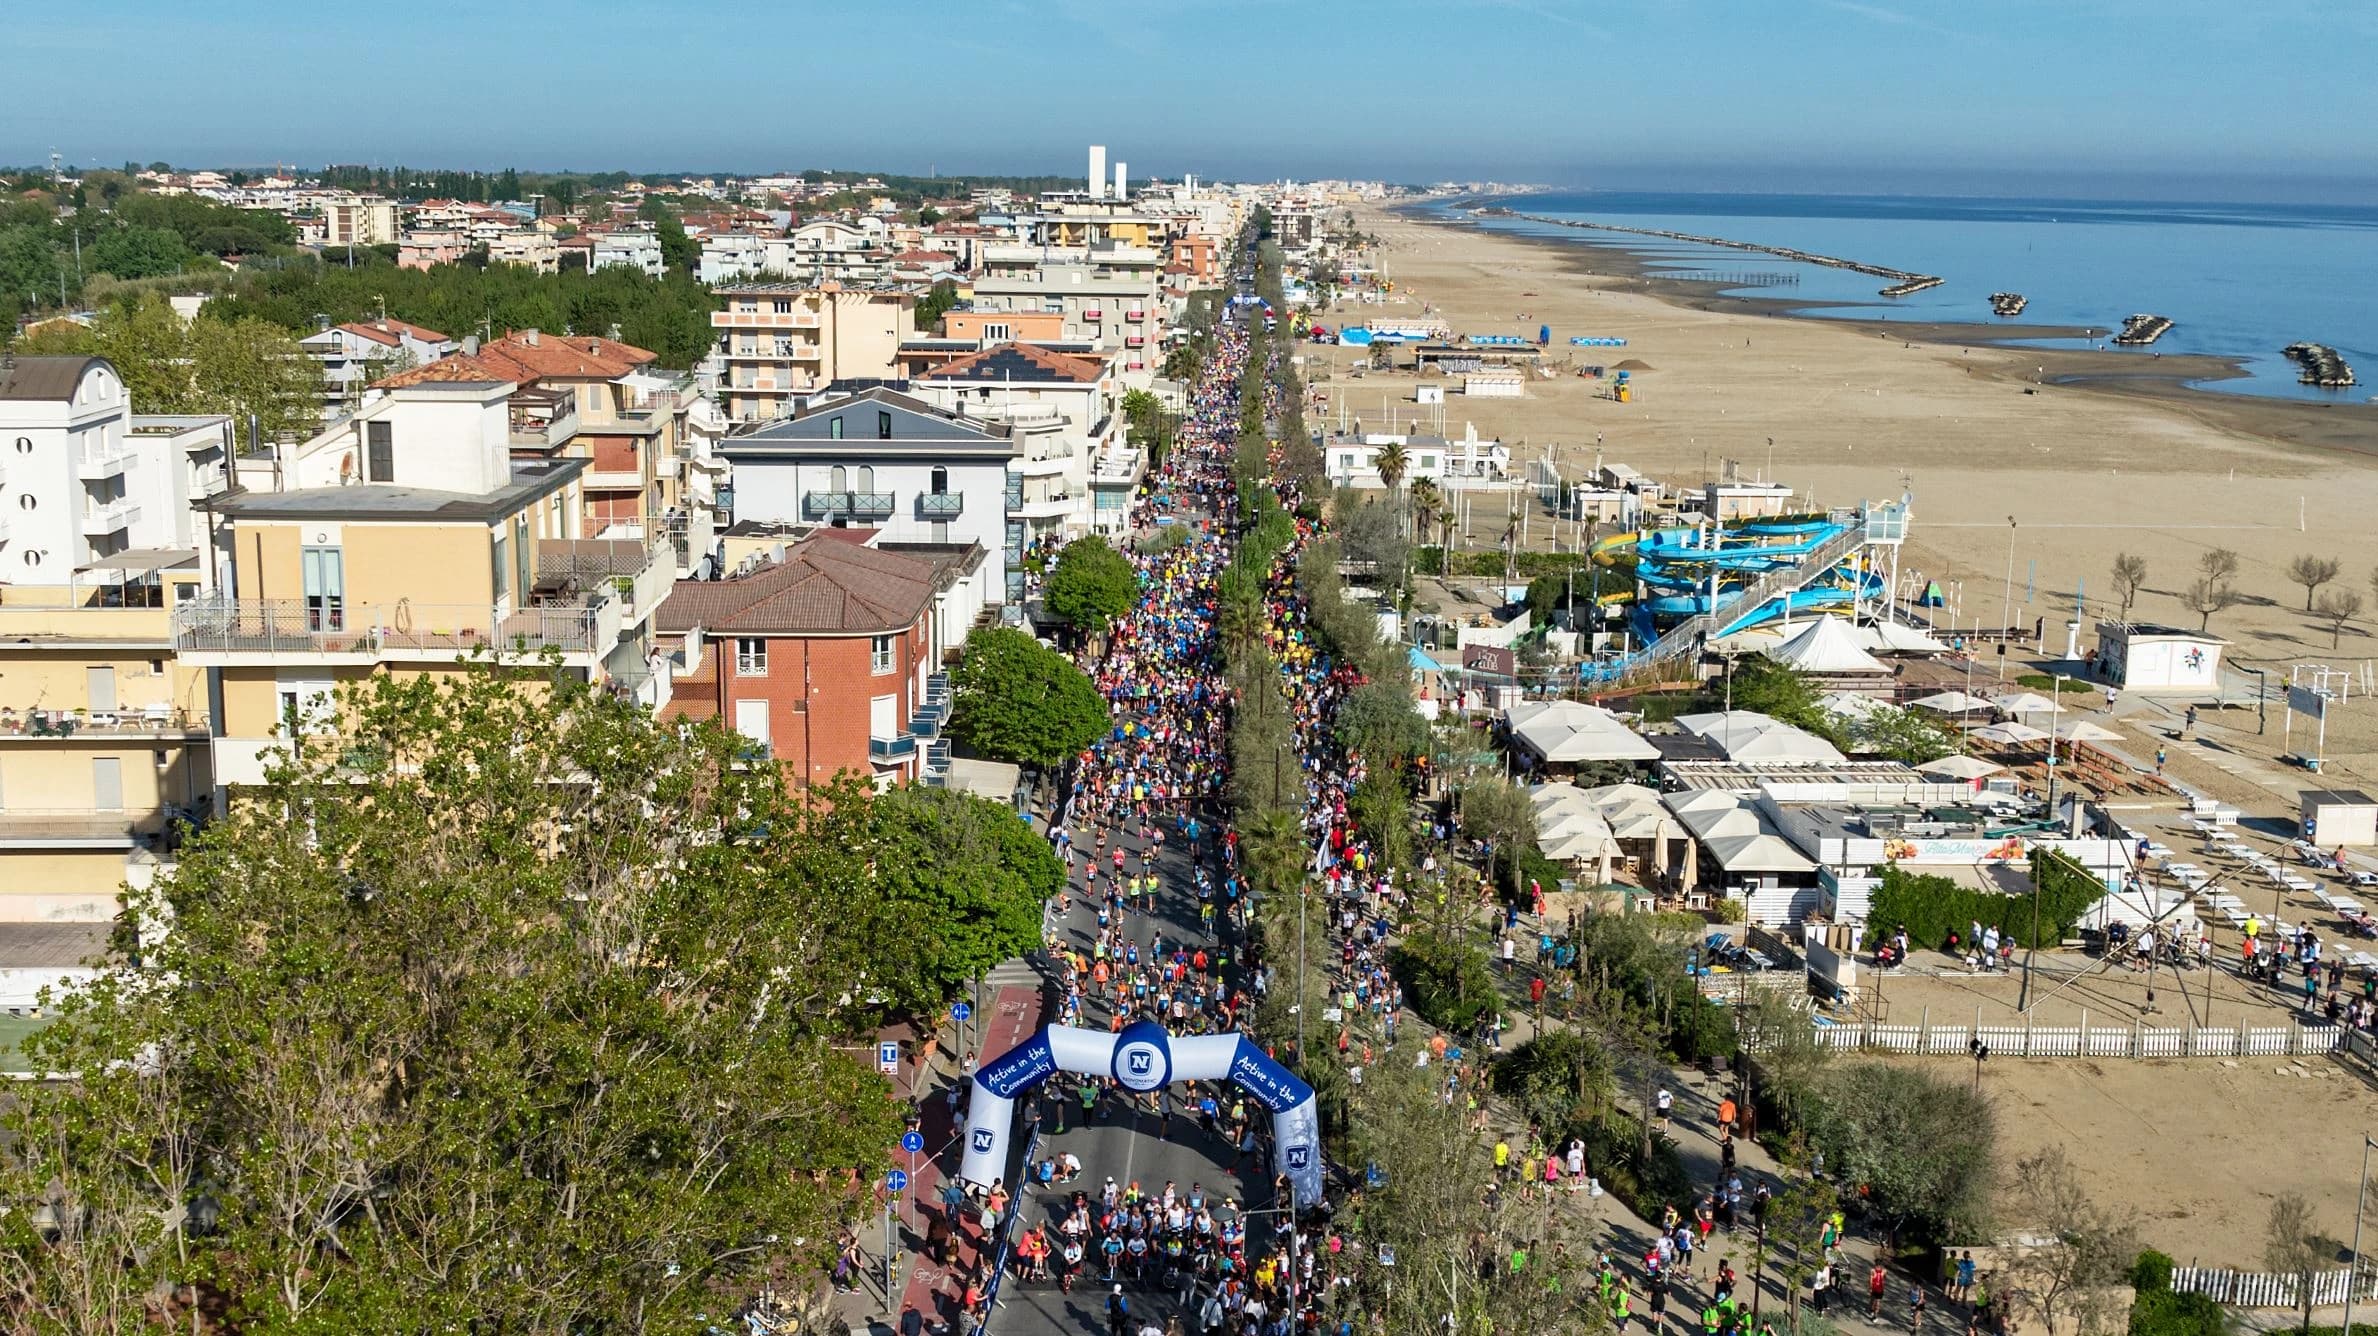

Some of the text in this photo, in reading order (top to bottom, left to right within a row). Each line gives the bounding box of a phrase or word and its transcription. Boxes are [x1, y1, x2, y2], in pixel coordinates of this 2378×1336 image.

[988, 1047, 1046, 1087] Active in the
[1000, 1062, 1051, 1095] Community
[1131, 1055, 1150, 1069] N
[1233, 1071, 1281, 1110] Community
[1236, 1055, 1296, 1104] Active in the
[975, 1133, 992, 1148] N
[1289, 1150, 1307, 1164] N
